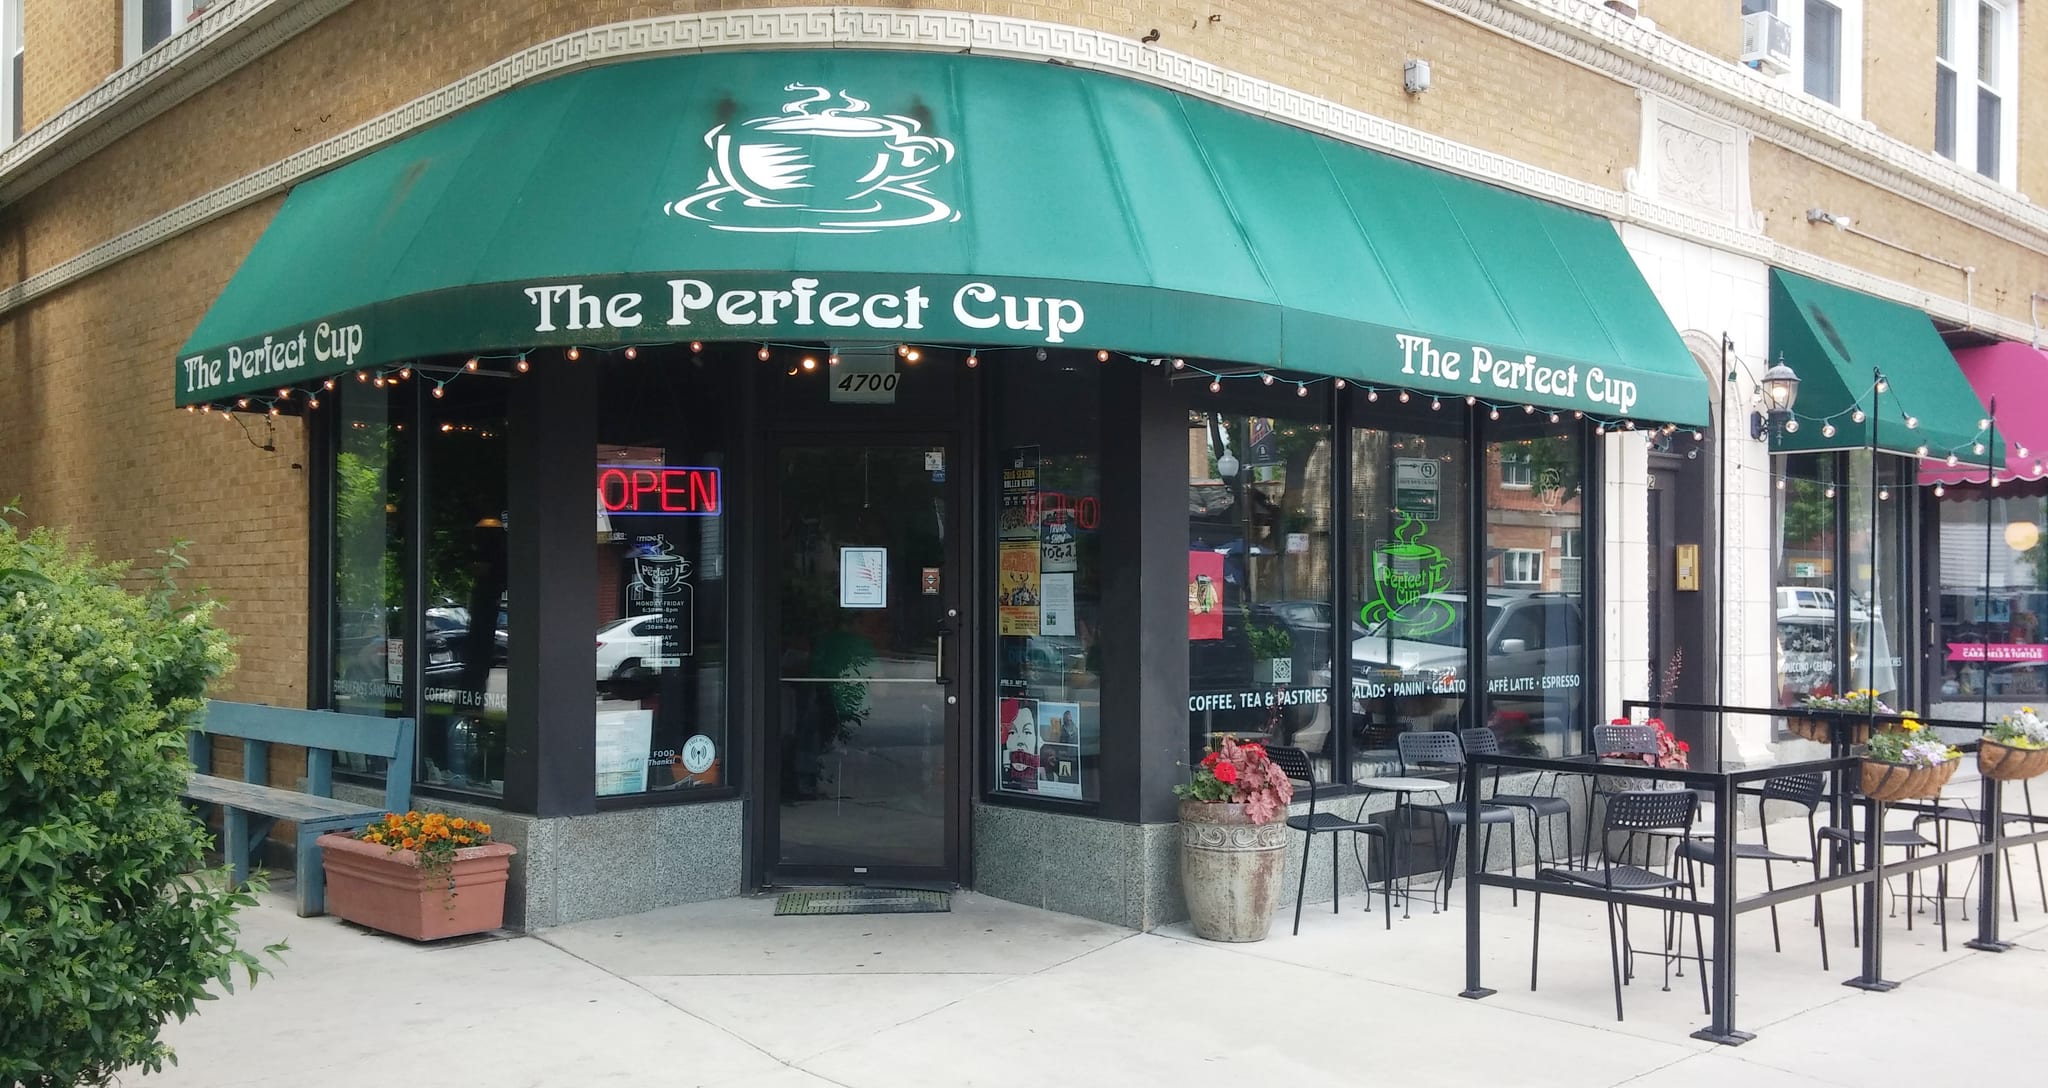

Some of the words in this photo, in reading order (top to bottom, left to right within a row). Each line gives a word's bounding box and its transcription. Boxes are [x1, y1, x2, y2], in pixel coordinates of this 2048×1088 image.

[524, 284, 643, 332] The
[667, 278, 930, 330] Perfect
[953, 283, 1085, 343] Cup
[184, 355, 222, 392] The
[227, 329, 307, 383] Perfect
[314, 322, 363, 365] Cup
[838, 374, 897, 392] 4700
[1395, 333, 1461, 381] The
[1469, 346, 1578, 398] Perfect
[1585, 367, 1637, 414] Cup
[600, 468, 717, 512] OPEN
[641, 565, 674, 578] Perfect
[652, 575, 670, 586] Cup
[1383, 566, 1426, 588] Perfect
[1396, 587, 1421, 607] Cup
[1393, 681, 1425, 697] PANINI
[1432, 679, 1466, 694] GELATO
[1486, 676, 1509, 693] AFFÈ
[1510, 677, 1534, 691] LATTE
[1542, 674, 1580, 689] ESPRESSO
[458, 690, 473, 705] TEA
[475, 691, 482, 706] &
[1189, 693, 1236, 712] COFFEE,
[1240, 692, 1261, 708] TEA
[1265, 691, 1274, 707] &
[1278, 688, 1328, 706] PASTRIES
[648, 757, 676, 766] Thanks!
[653, 749, 675, 758] FOOD
